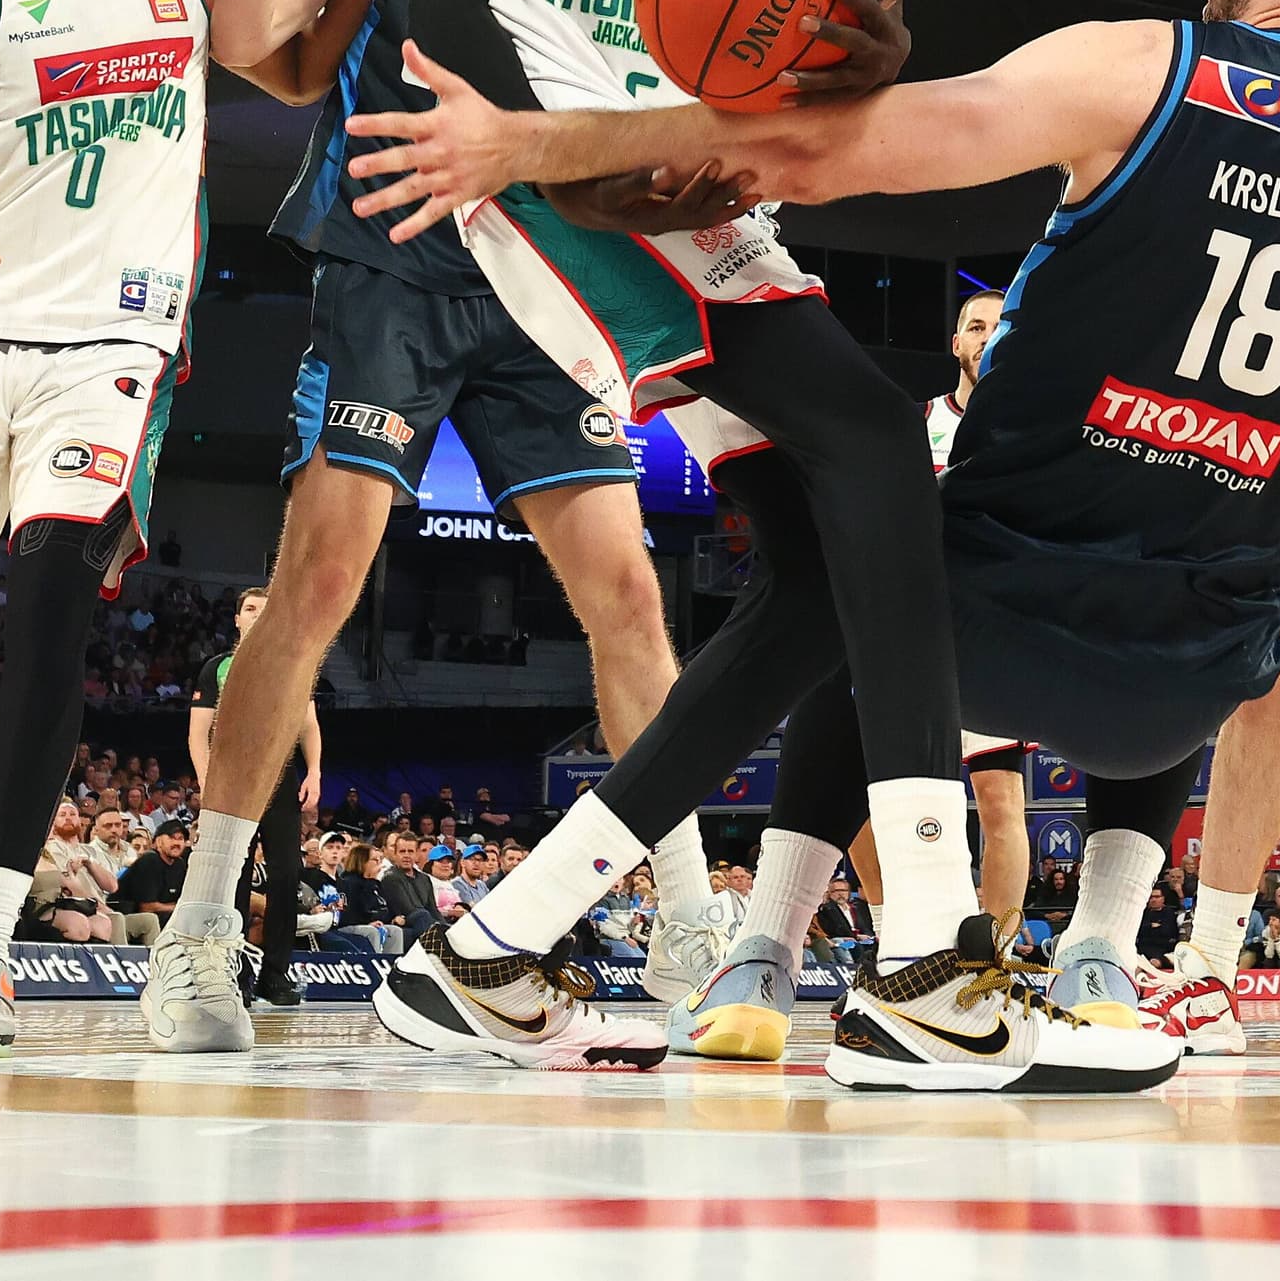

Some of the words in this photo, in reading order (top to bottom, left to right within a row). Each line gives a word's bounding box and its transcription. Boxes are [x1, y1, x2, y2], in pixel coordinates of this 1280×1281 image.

[8, 24, 75, 44] MyStateBank
[96, 51, 159, 75] SPIRIT
[158, 50, 177, 65] of
[96, 68, 172, 86] TASMAN
[65, 144, 106, 209] 0
[703, 239, 760, 282] UNIVERSITY
[709, 246, 772, 289] TASMANIA
[1081, 425, 1142, 458] TOOLS
[1144, 448, 1200, 470] BUILT
[419, 516, 491, 538] JOHN
